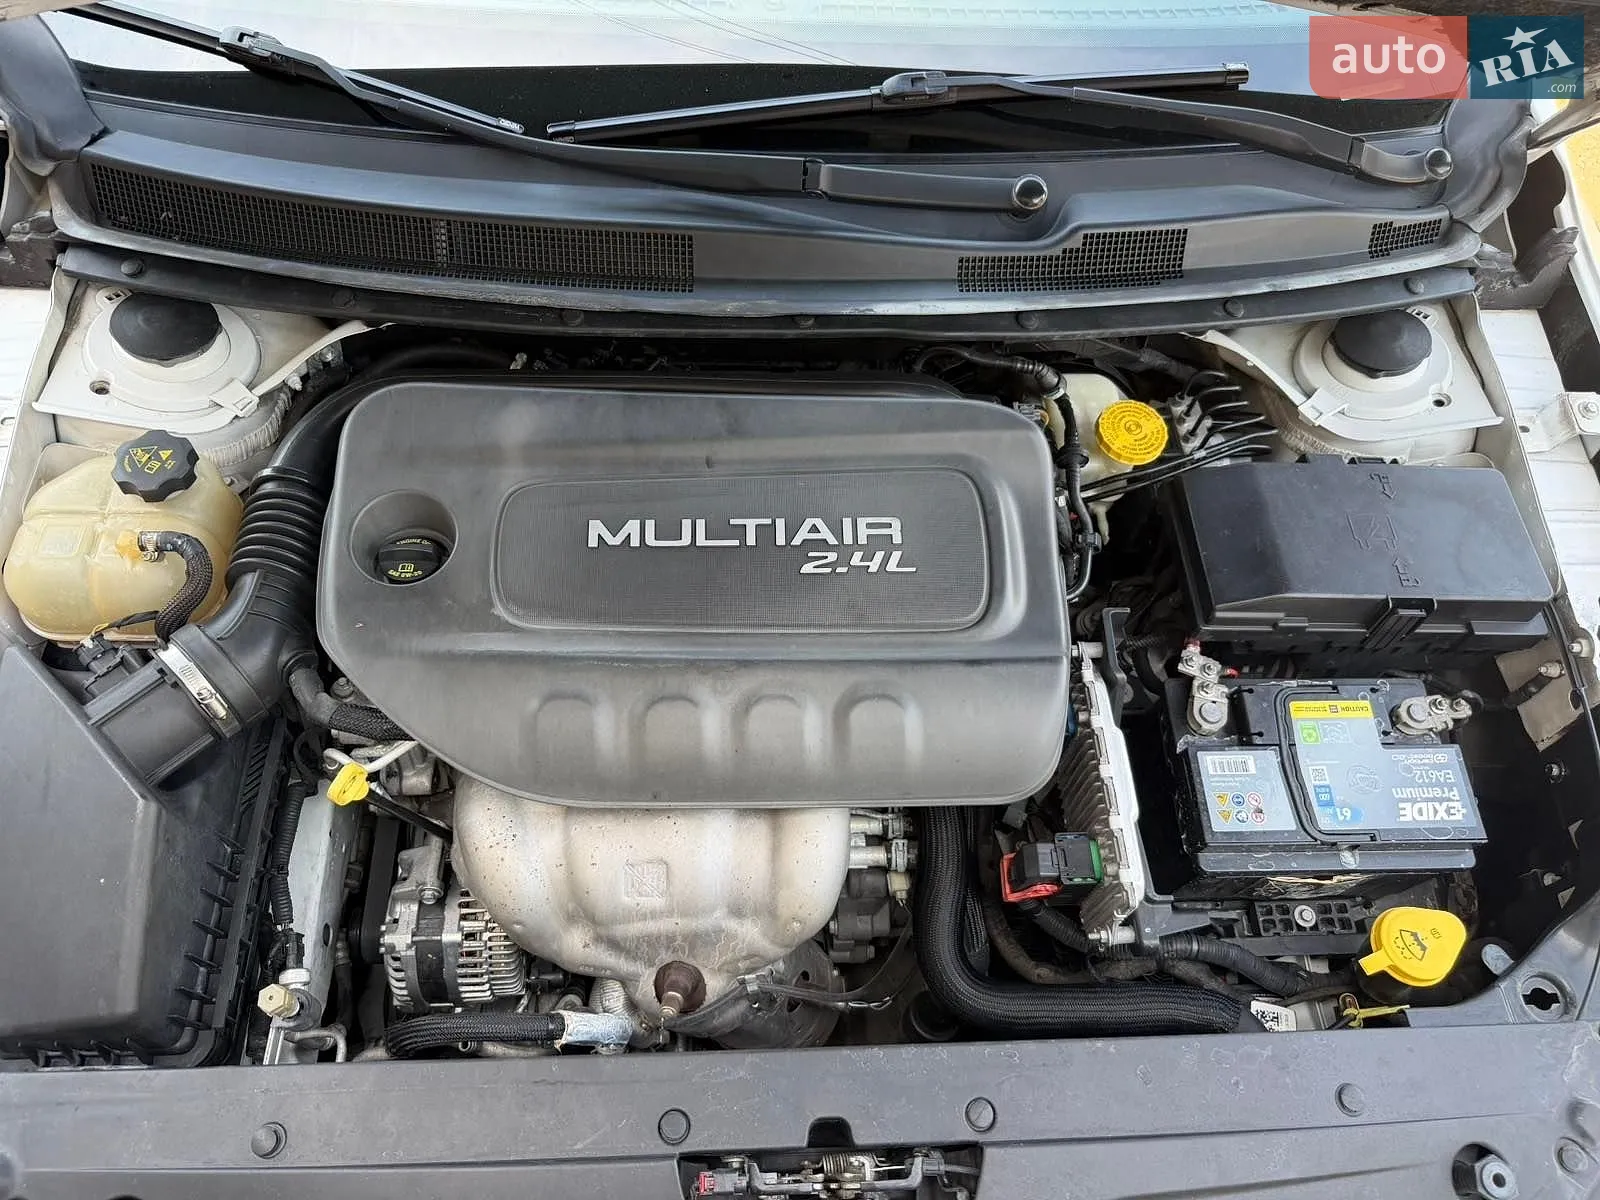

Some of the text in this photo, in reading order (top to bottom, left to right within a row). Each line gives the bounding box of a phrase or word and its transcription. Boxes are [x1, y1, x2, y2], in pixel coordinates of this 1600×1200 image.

[587, 517, 903, 548] MULTIAIR
[799, 550, 917, 574] 2.4L
[1340, 705, 1369, 713] CAUTION
[1411, 769, 1455, 783] EA612
[1391, 786, 1460, 801] Premium
[1335, 807, 1351, 820] 61
[1398, 801, 1467, 821] EXIDE
